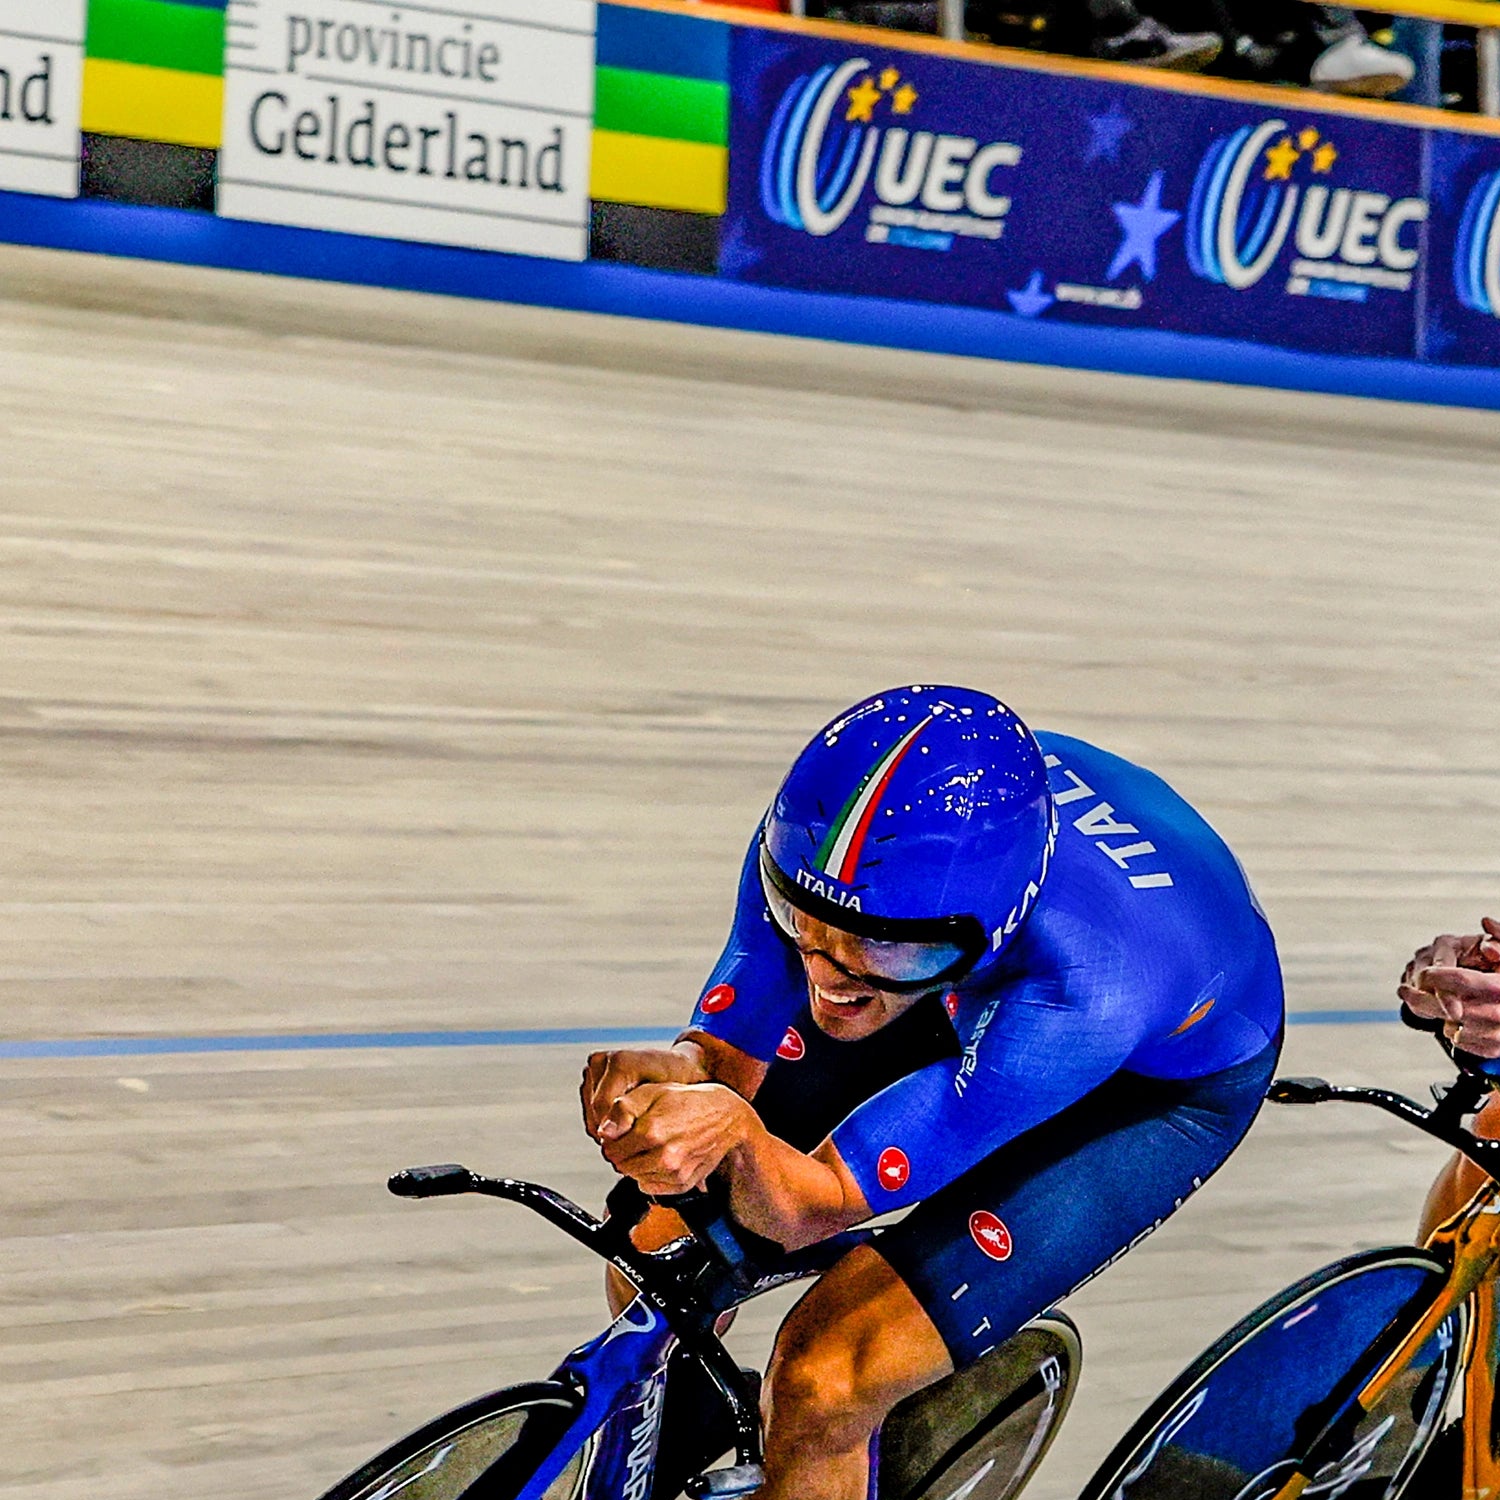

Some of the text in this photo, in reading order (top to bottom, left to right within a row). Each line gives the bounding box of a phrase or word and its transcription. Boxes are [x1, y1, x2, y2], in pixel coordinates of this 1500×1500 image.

[285, 13, 501, 82] provincie
[249, 91, 567, 194] Gelderland
[874, 126, 1023, 218] UEC
[1296, 186, 1430, 270] UEC
[796, 868, 862, 913] ITALIA
